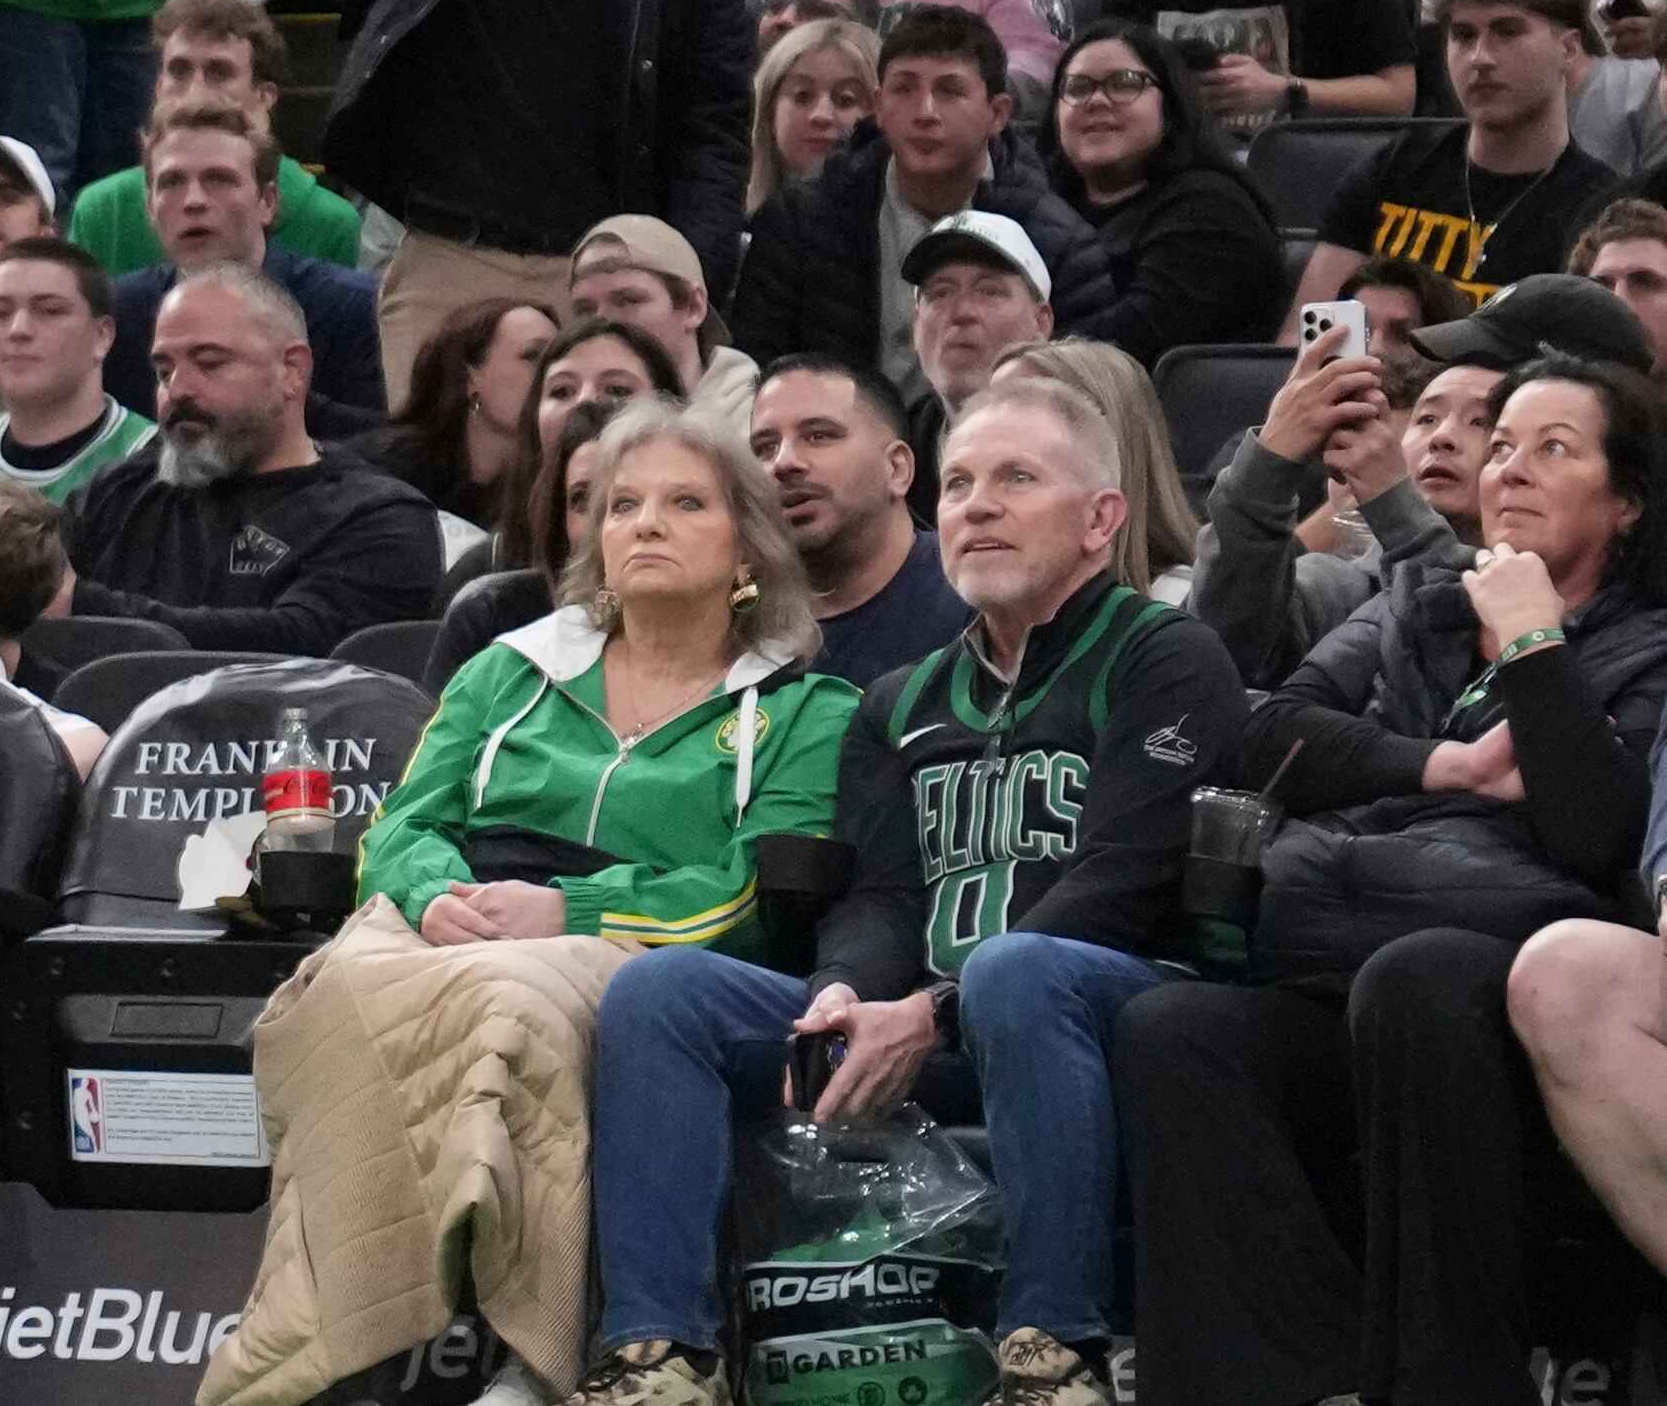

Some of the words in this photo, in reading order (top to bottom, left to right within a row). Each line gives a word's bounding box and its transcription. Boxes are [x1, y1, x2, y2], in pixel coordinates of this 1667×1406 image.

[1374, 201, 1499, 281] TITTY
[914, 750, 1091, 887] ELTICS
[749, 1265, 941, 1312] ROSHOP
[793, 1340, 927, 1374] GARDEN
